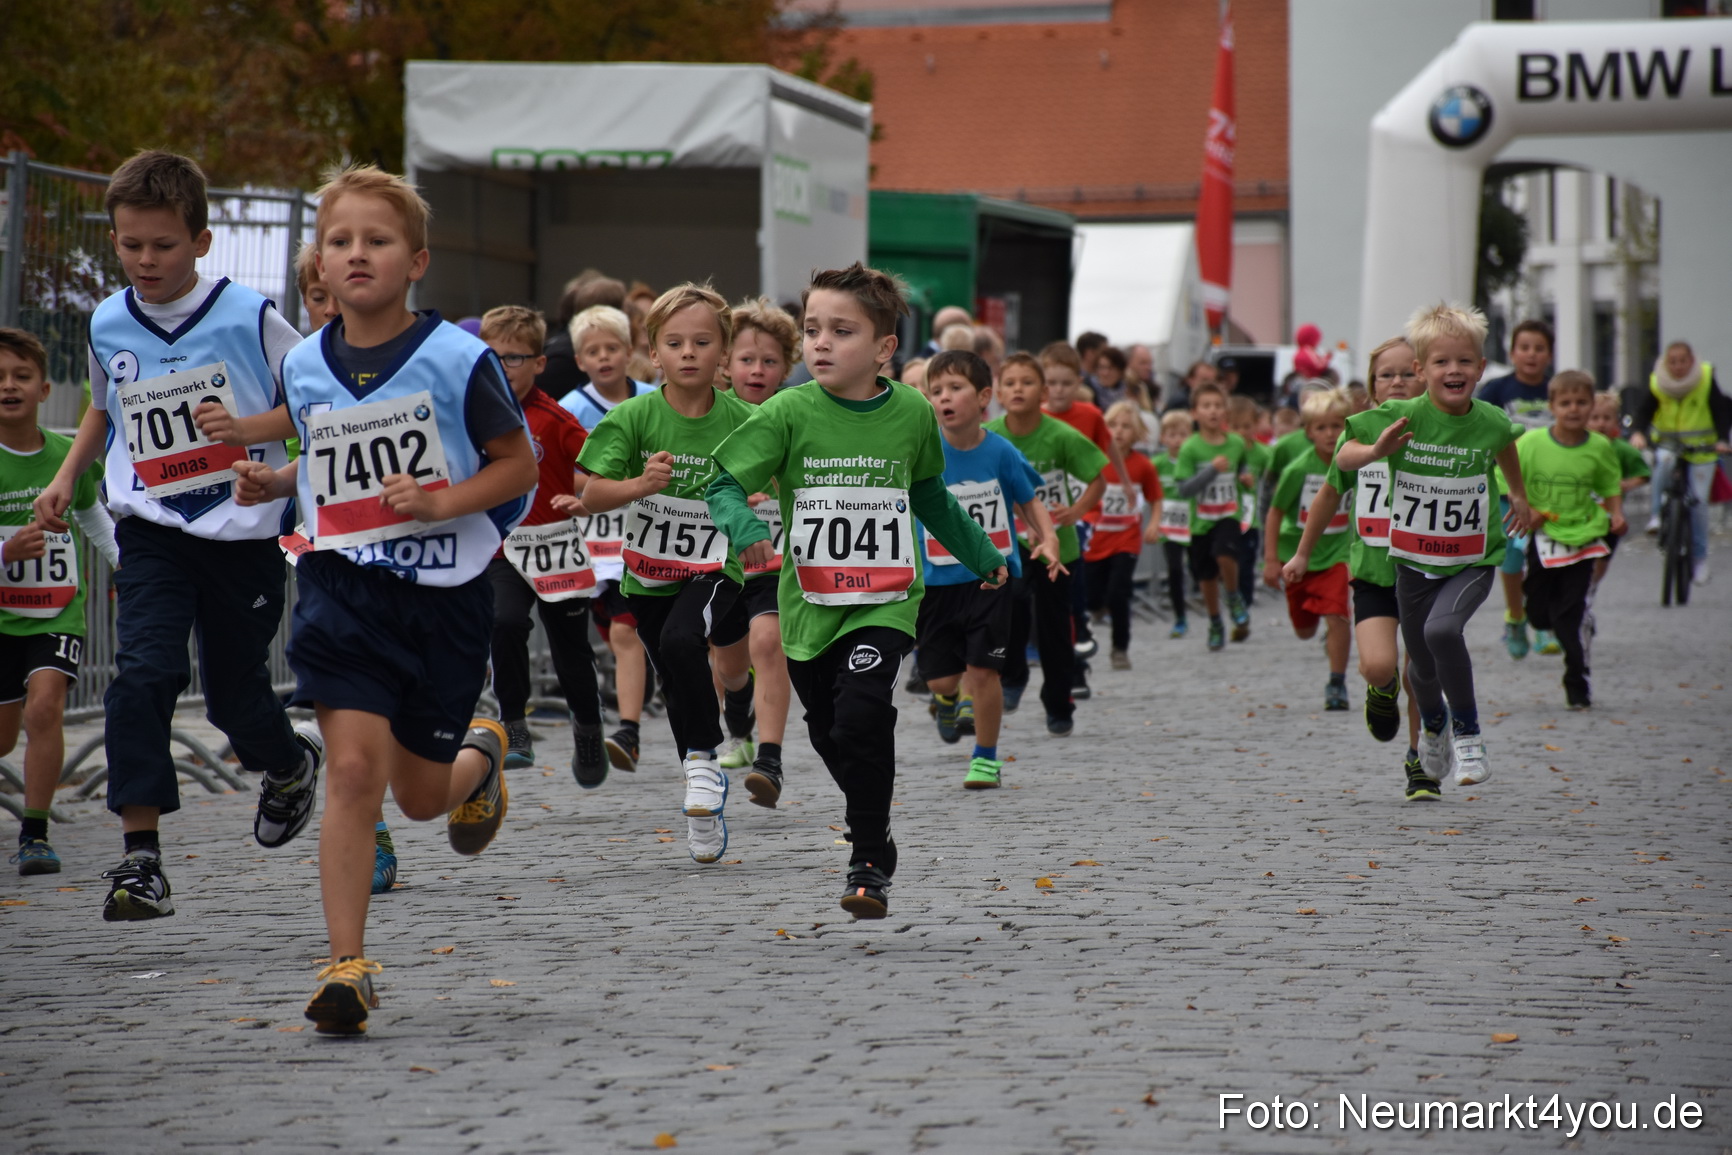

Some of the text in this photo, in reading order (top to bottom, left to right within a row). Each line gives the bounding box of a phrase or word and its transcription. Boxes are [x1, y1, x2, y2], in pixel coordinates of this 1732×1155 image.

[1518, 48, 1690, 103] BMW
[146, 380, 208, 402] Neumarkt
[131, 395, 223, 455] 701
[341, 411, 409, 435] Neumarkt
[1406, 439, 1468, 456] Neumarkter
[160, 456, 209, 480] Jonas
[315, 429, 434, 496] 7402
[803, 455, 888, 469] Neumarkter
[1404, 452, 1456, 469] Stadtlauf
[804, 472, 871, 487] Stadtlauf
[1359, 470, 1387, 479] PARTL
[1397, 480, 1476, 495] PARTL Neumarkt
[633, 498, 661, 513] PARTL
[796, 498, 893, 511] PARTL Neumarkt
[1403, 495, 1481, 533] 7154
[636, 512, 719, 560] 7157
[802, 517, 901, 561] 7041
[514, 537, 586, 573] 7073
[1417, 538, 1461, 554] Tobias
[636, 558, 705, 580] Alexander
[537, 578, 576, 593] Simon
[834, 572, 871, 588] Paul
[1, 591, 53, 605] Lennart
[55, 635, 81, 665] 10
